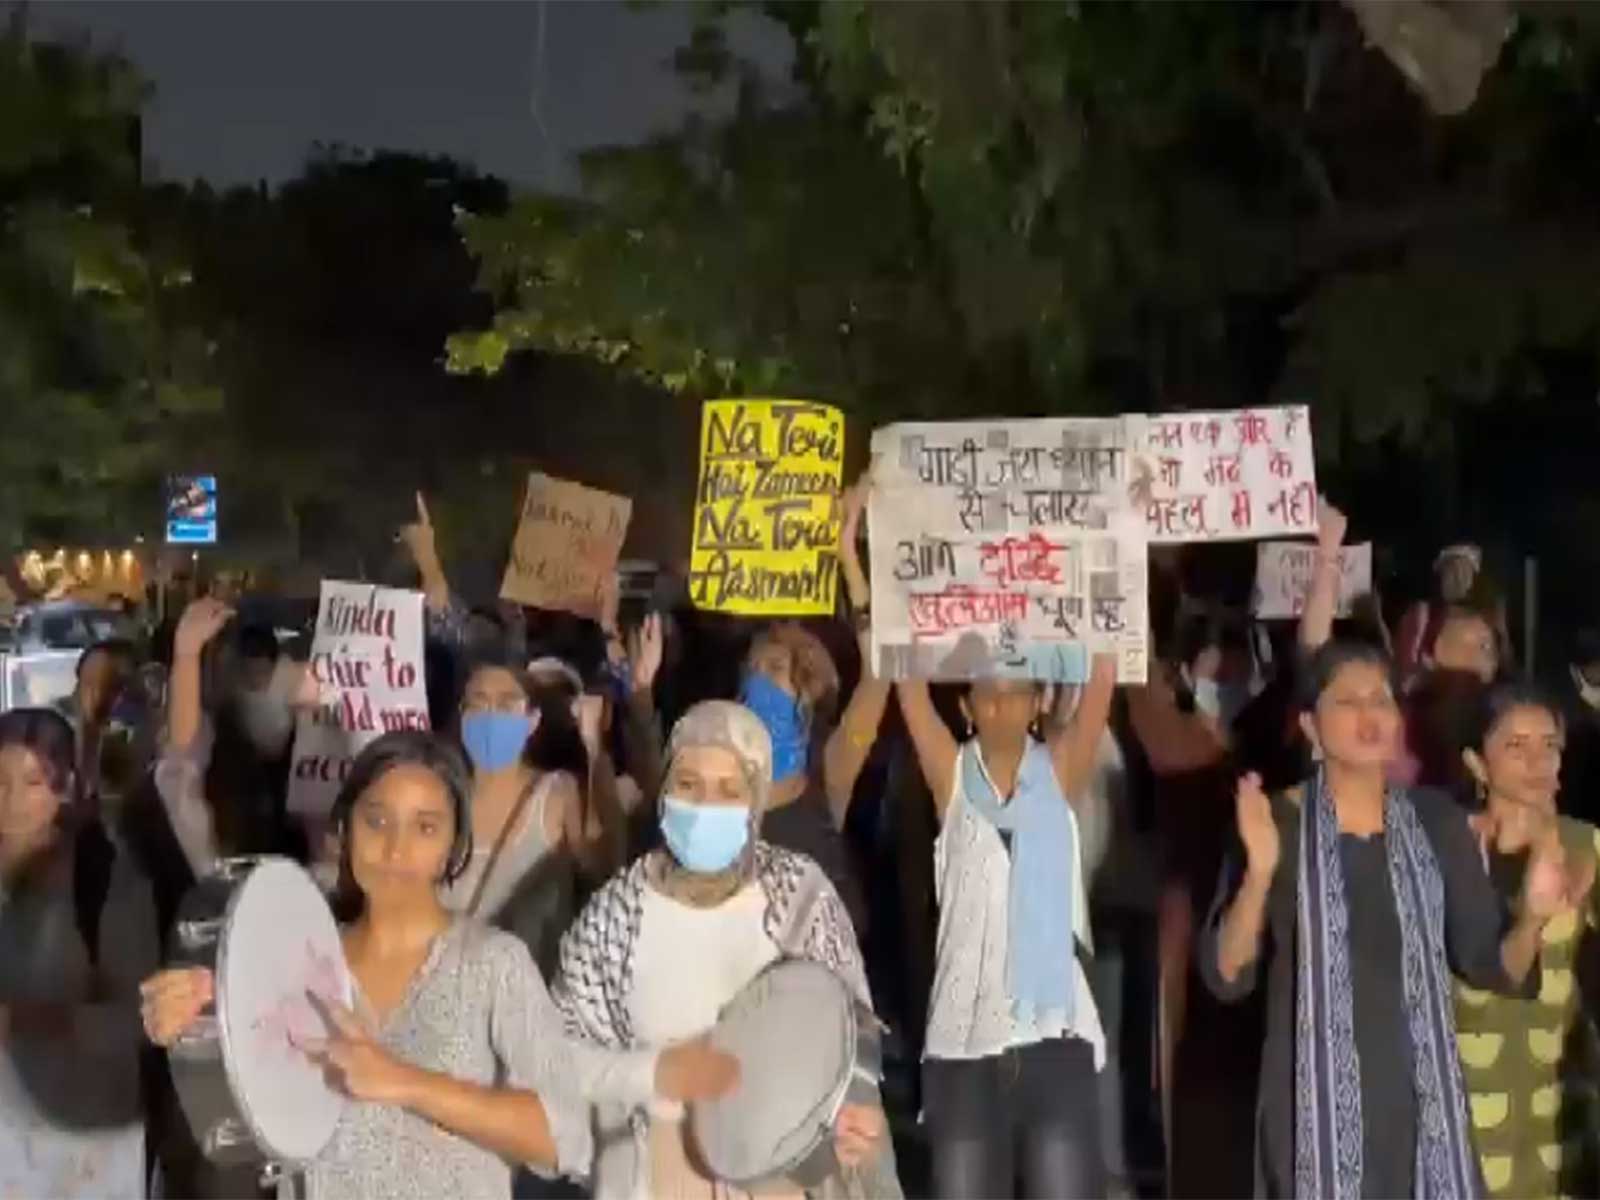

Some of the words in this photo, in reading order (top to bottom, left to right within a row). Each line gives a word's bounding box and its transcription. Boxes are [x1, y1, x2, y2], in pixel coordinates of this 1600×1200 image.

[706, 404, 763, 456] Na
[770, 405, 840, 461] Teri
[698, 502, 761, 547] Na
[384, 644, 416, 690] to
